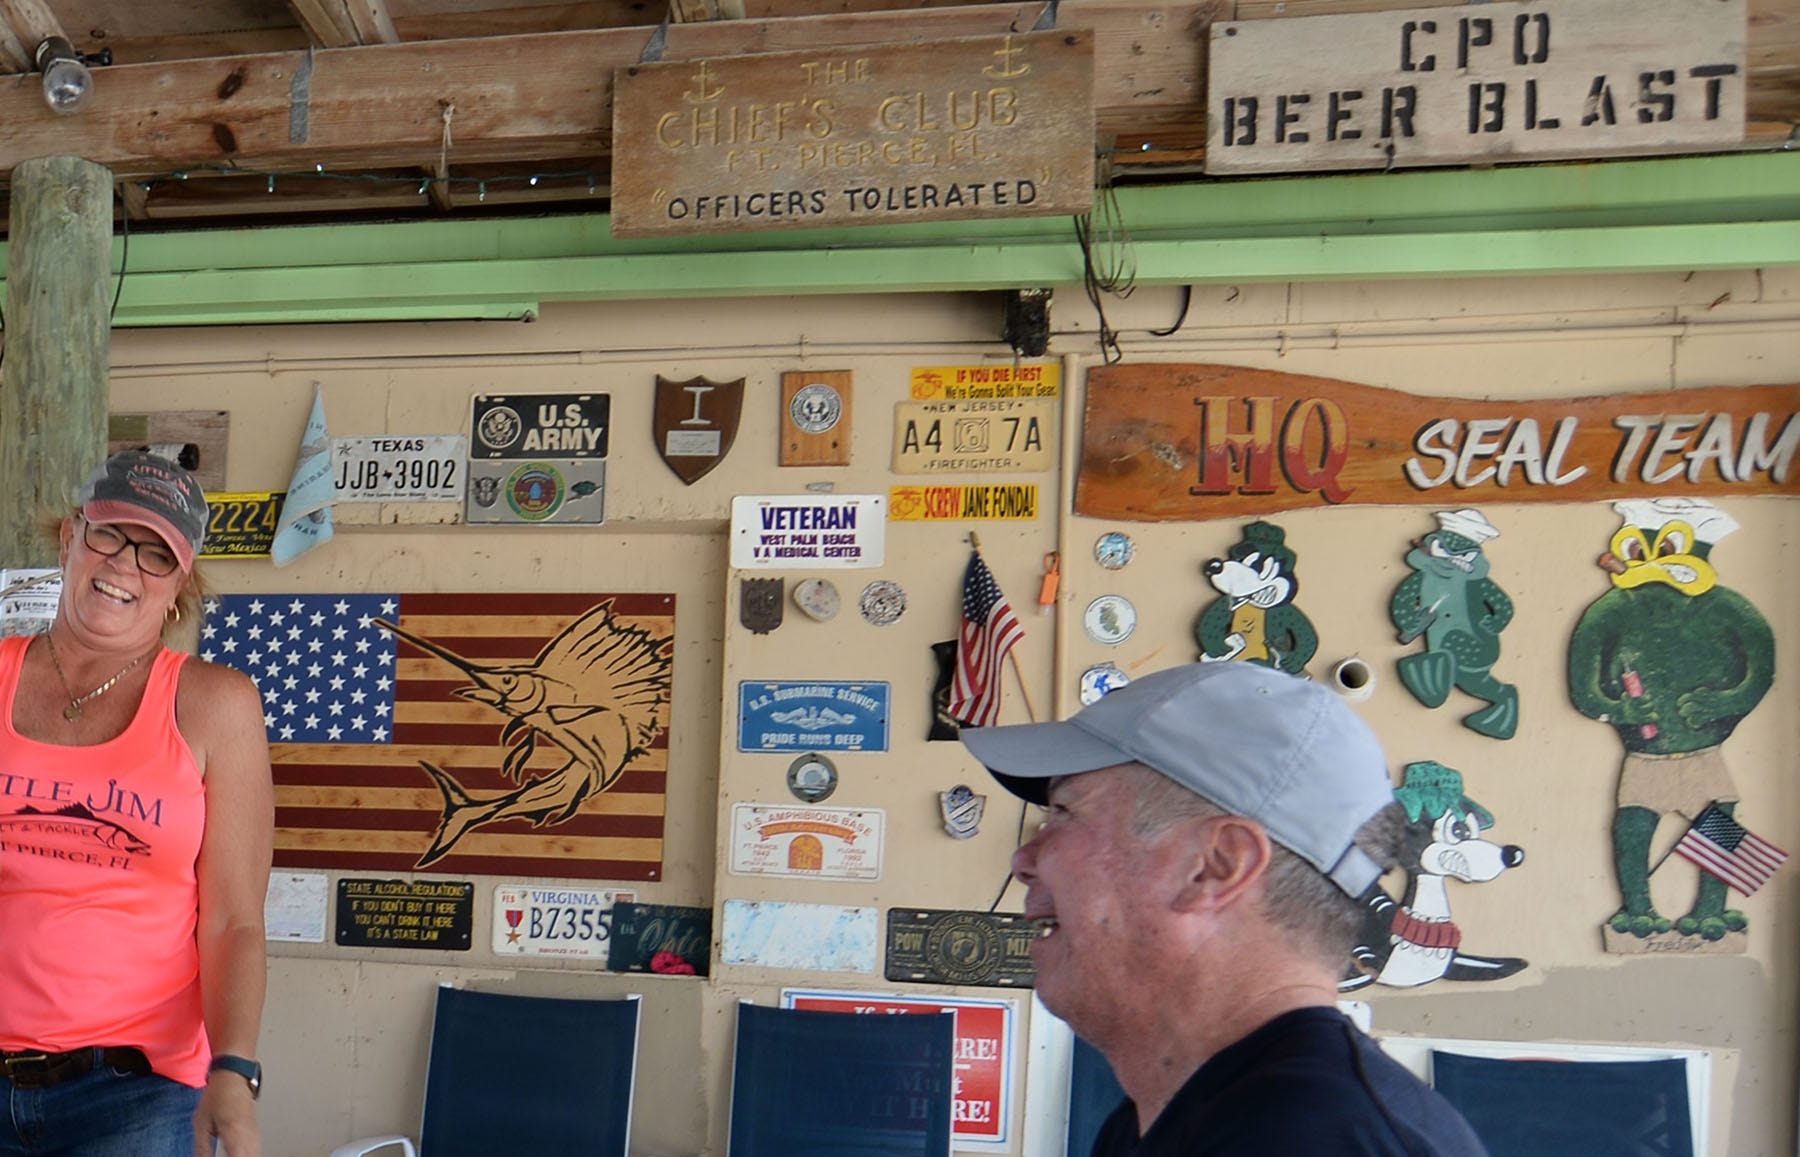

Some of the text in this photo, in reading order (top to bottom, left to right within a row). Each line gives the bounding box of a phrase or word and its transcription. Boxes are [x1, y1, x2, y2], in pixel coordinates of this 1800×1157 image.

[1401, 13, 1549, 71] CPO
[801, 58, 871, 85] THE
[1224, 64, 1737, 146] BEER BLAST
[657, 88, 1018, 149] CHIEF'S CLUB
[728, 150, 780, 172] FT.
[801, 138, 938, 169] PIERCE,
[956, 367, 1042, 383] IF YOU DIE FIRST
[538, 403, 589, 428] U.S.
[930, 402, 1014, 413] NEW JERSEY
[372, 439, 424, 452] TEXAS
[522, 427, 603, 451] ARMY
[902, 416, 1042, 454] A4 7A
[1192, 395, 1800, 503] HQ SEAL TEAM
[335, 460, 379, 490] JJB
[394, 459, 456, 489] 3902
[930, 458, 1012, 469] FIREFIGHTER
[924, 485, 1036, 518] SCREW JANE FONDA!
[761, 506, 856, 530] VETERAN
[760, 534, 856, 546] WEST PALM BEACH
[775, 546, 819, 558] MEDICAL
[823, 546, 861, 558] CENTER
[773, 686, 835, 701] SUBMARINE
[836, 688, 881, 712] SERVICE
[761, 733, 865, 745] PRIDE RUNS DEEP
[87, 778, 163, 829] JIM
[768, 810, 839, 823] AMPHIBIOUS
[841, 815, 873, 837] BASE
[17, 843, 103, 868] PIERCE,
[109, 856, 135, 872] FL
[346, 882, 465, 897] STATE ALCOHOL REGULATIONS
[531, 891, 599, 905] VIRGINIA
[363, 901, 379, 912] YOU
[406, 901, 423, 913] BUY
[436, 903, 457, 915] HERE
[355, 914, 371, 925] YOU
[397, 915, 420, 926] DRINK
[433, 916, 454, 928] HERE
[383, 929, 391, 939] A
[393, 929, 418, 940] STATE
[421, 930, 440, 941] LAW
[894, 932, 923, 951] POW
